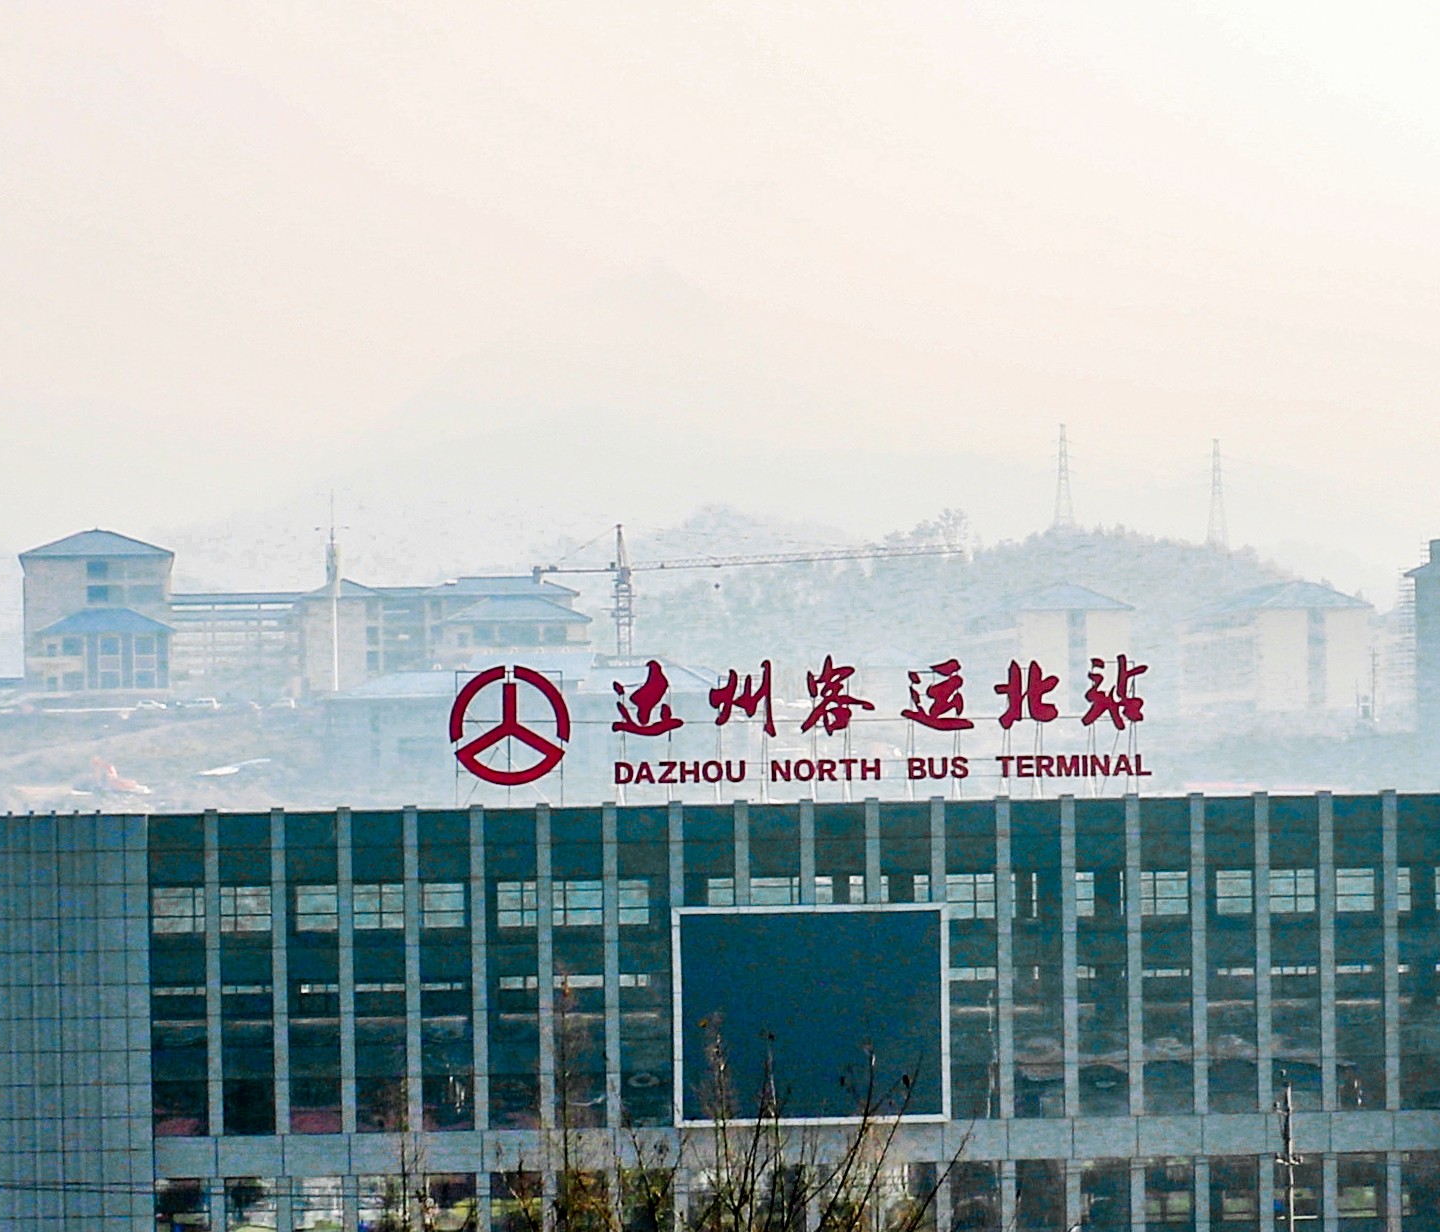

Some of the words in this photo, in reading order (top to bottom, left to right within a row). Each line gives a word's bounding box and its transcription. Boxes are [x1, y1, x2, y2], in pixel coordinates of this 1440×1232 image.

[612, 655, 1148, 737] 达州客运北站
[614, 760, 747, 784] DAZHOU
[771, 758, 882, 782] NORTH
[908, 756, 970, 779] BUS
[998, 754, 1152, 777] TERMINAL
